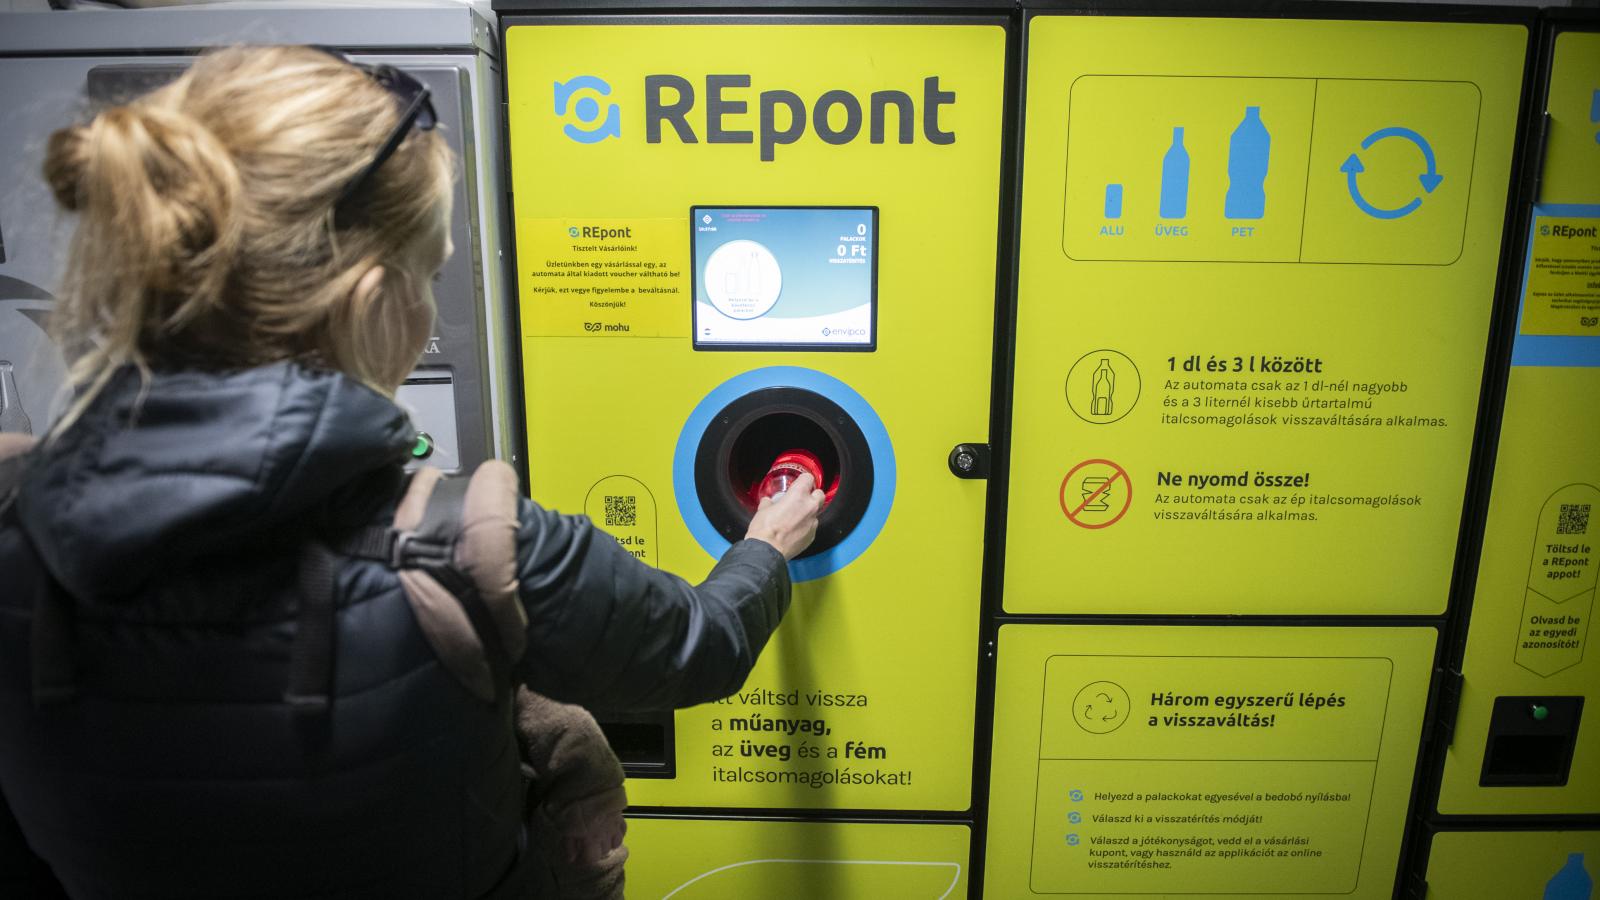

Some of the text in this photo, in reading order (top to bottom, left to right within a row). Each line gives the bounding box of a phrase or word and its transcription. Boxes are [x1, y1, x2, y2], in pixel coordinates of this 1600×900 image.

[645, 74, 956, 162] REpont
[583, 227, 631, 240] REpont
[857, 224, 866, 235] 0
[1100, 226, 1124, 236] ALU
[1154, 224, 1189, 236] ÜVEG
[1232, 228, 1255, 237] PET
[1552, 225, 1597, 239] REpont
[837, 245, 866, 256] 0 Ft
[592, 287, 630, 295] figyelembe
[604, 323, 630, 332] mohu
[832, 328, 866, 336] envipco
[1168, 356, 1323, 373] 1 dl és 3 l között
[1164, 380, 1408, 396] Az automata csak az 1 dl-nél nagyobb
[1164, 397, 1178, 408] és
[1182, 400, 1189, 408] a
[1193, 397, 1201, 408] 3
[1205, 396, 1251, 408] liternél
[1254, 398, 1298, 409] kisebb
[1162, 414, 1449, 428] italcsomagolások visszaváltására alkalmas.
[1157, 472, 1310, 489] Ne nyomd össze!
[1155, 494, 1422, 508] Az automata csak az ép italcsomagolások
[1154, 510, 1318, 521] visszaváltására alkalmas.
[635, 536, 645, 545] le
[1546, 544, 1591, 554] Töltsd le
[1551, 557, 1589, 568] REpont
[1546, 570, 1581, 580] appot!
[1530, 616, 1580, 625] Olvasd be
[1543, 628, 1577, 639] egyedi
[1522, 639, 1580, 649] azonosítót!
[739, 688, 799, 705] váltsd
[806, 690, 868, 707] vissza
[1151, 692, 1346, 710] Három egyszerű lépés
[712, 714, 831, 736] a műanyag,
[1148, 713, 1275, 727] a visszaváltás!
[712, 740, 886, 761] az üveg és a fém
[713, 766, 912, 789] italcsomagolásokat!
[1094, 792, 1134, 803] Helyezd
[1145, 792, 1202, 803] palackokat
[1204, 792, 1254, 803] egyesével
[1265, 792, 1303, 802] bedobó
[1305, 792, 1350, 803] nyílásba!
[1092, 814, 1132, 823] Válaszd
[1134, 814, 1144, 823] ki
[1155, 814, 1221, 824] visszatérítés
[1222, 814, 1263, 825] módját!
[1090, 836, 1130, 845] Válaszd
[1140, 836, 1215, 847] jótékonyságot,
[1217, 836, 1242, 846] vedd
[1244, 836, 1253, 846] el
[1264, 836, 1309, 846] vásárlási
[1089, 848, 1128, 859] kupont,
[1130, 850, 1154, 859] vagy
[1156, 848, 1202, 857] használd
[1218, 848, 1275, 859] applikációt
[1290, 849, 1322, 858] online
[1088, 860, 1172, 869] visszatérítéshez.
